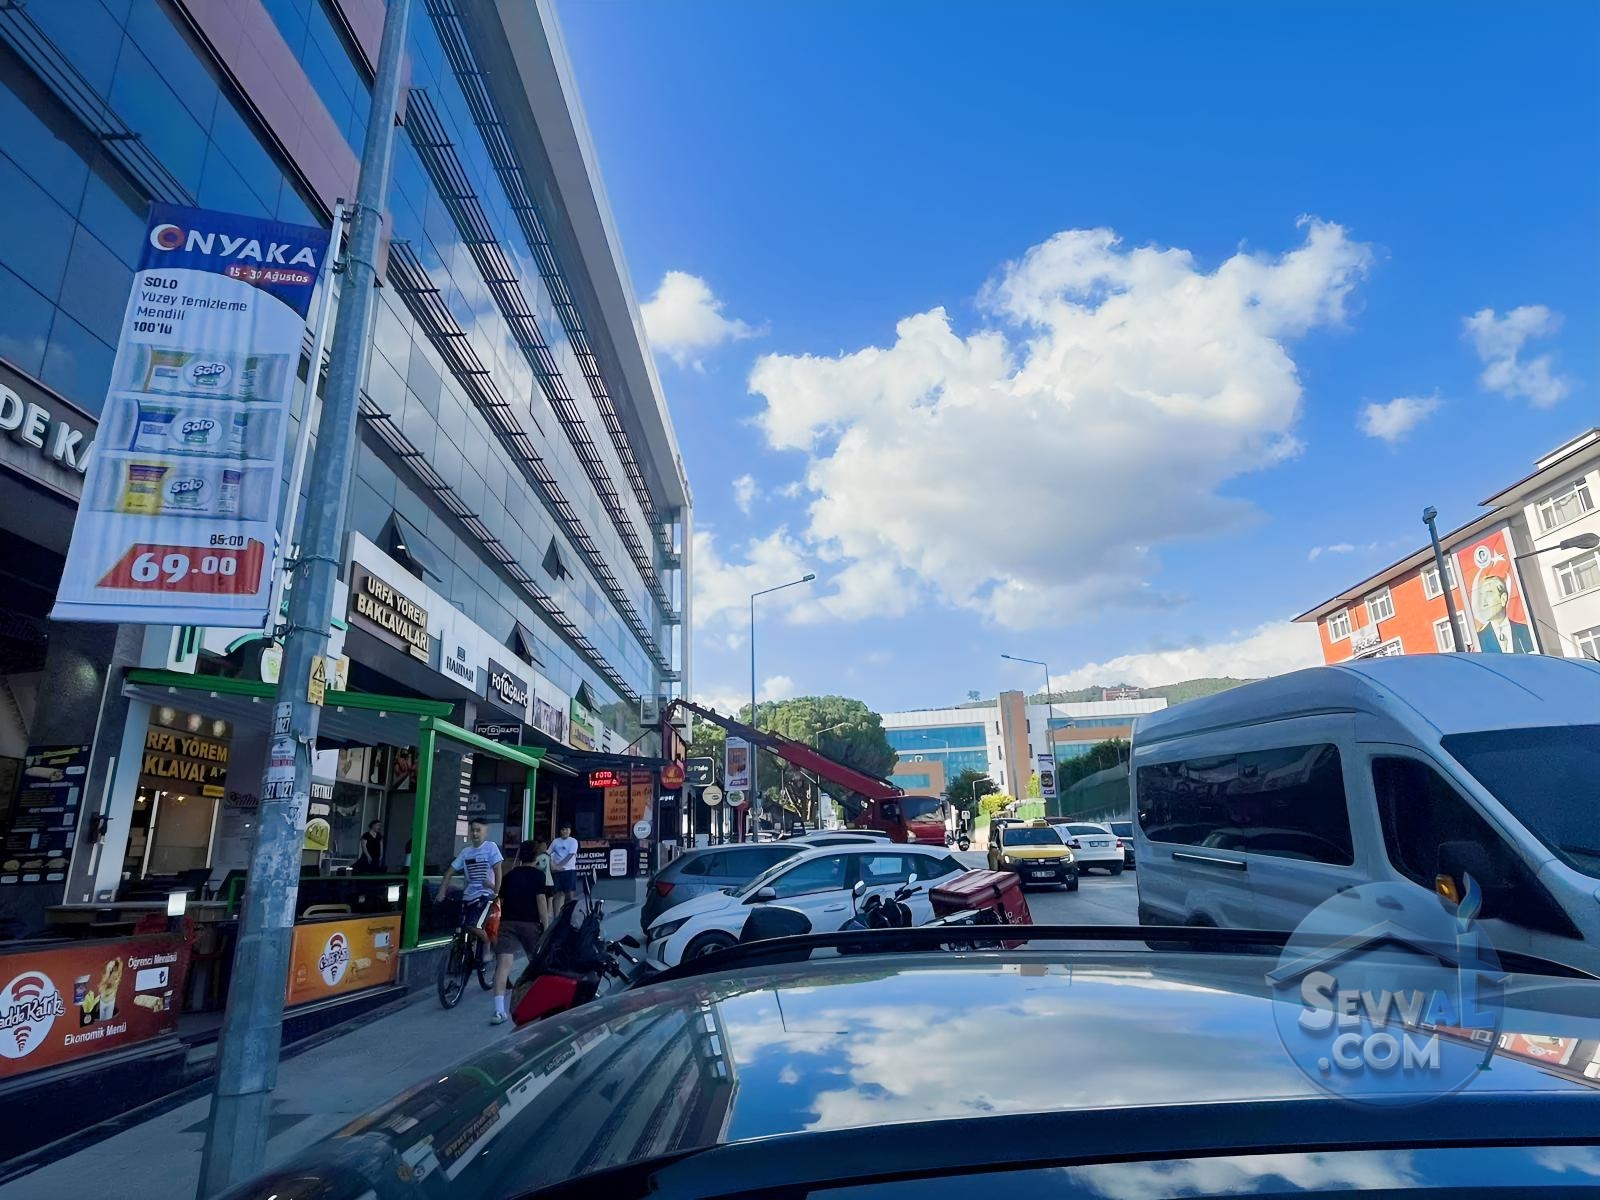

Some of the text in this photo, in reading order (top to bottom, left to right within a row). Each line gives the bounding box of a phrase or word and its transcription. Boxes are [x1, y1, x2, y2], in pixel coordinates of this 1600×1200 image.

[150, 223, 316, 268] ONYAKA
[143, 276, 178, 290] SOLO
[229, 266, 240, 277] 15
[264, 271, 308, 284] Ağustos
[181, 295, 247, 312] Temizleme
[136, 305, 185, 321] Mendili
[209, 534, 244, 547] 85.00
[367, 575, 394, 608] URFA
[357, 592, 430, 652] BAKLAVALARI
[64, 1022, 127, 1046] Ekonomik Menü
